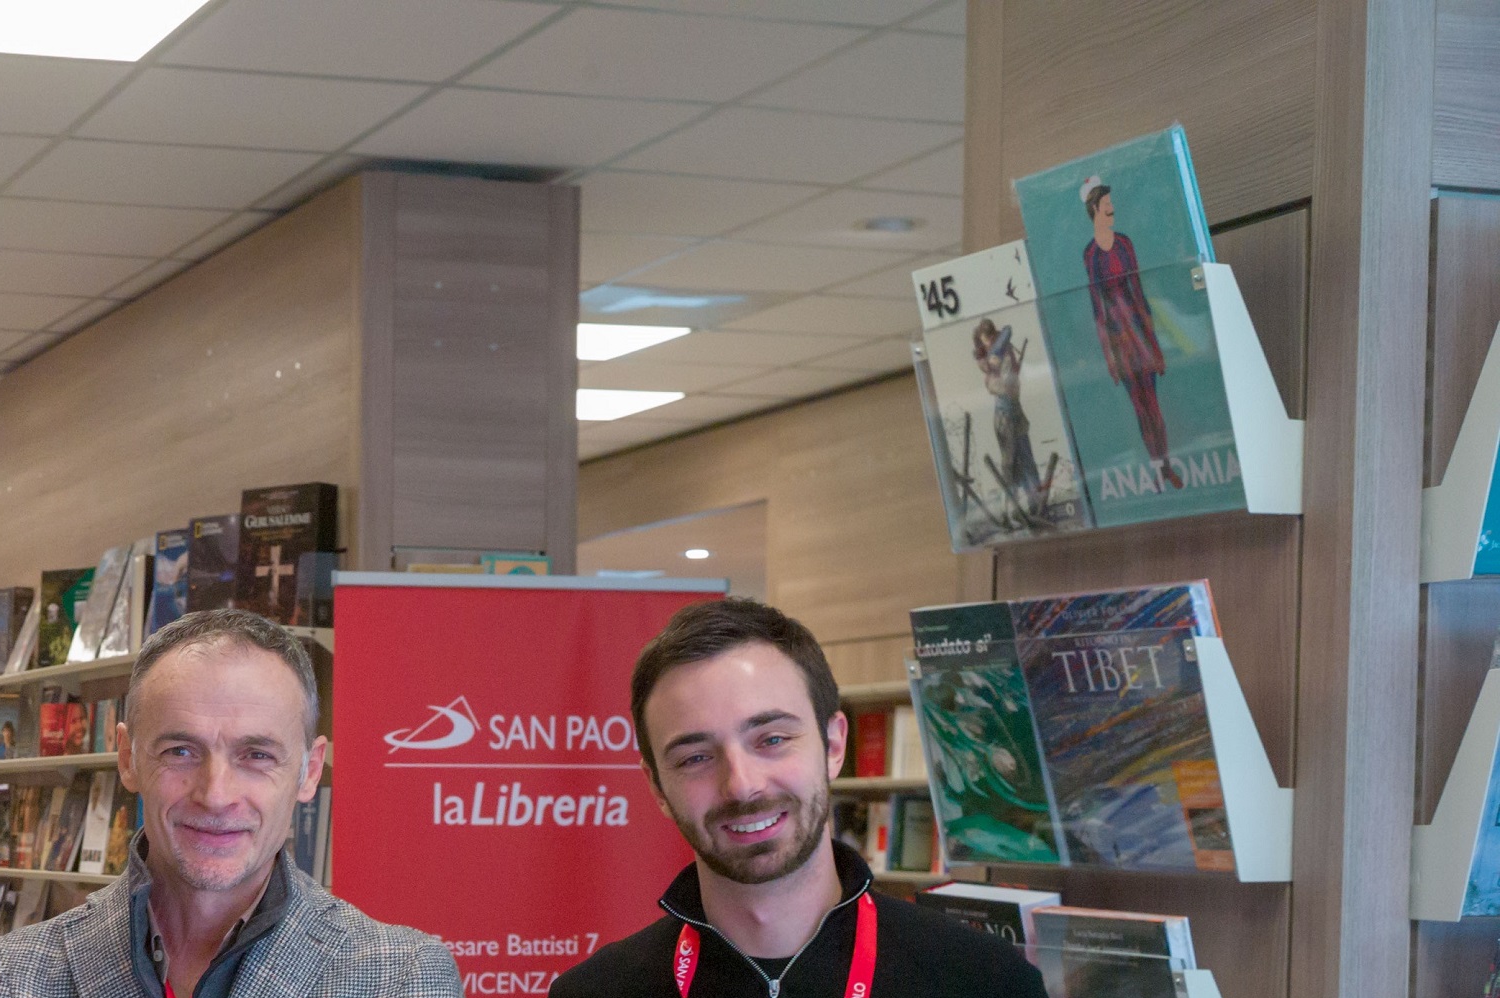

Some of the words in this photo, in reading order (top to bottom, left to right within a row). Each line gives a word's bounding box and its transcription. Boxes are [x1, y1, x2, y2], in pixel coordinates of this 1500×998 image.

[920, 276, 961, 318] '45
[1102, 451, 1240, 501] ANATOMIA
[915, 635, 970, 659] Laudato
[1052, 645, 1165, 694] TIBET
[489, 714, 556, 751] SAN
[433, 782, 629, 827] laLibreria
[432, 934, 499, 956] esare
[507, 934, 578, 956] Battisti
[585, 933, 599, 955] 7
[677, 956, 691, 979] SAN
